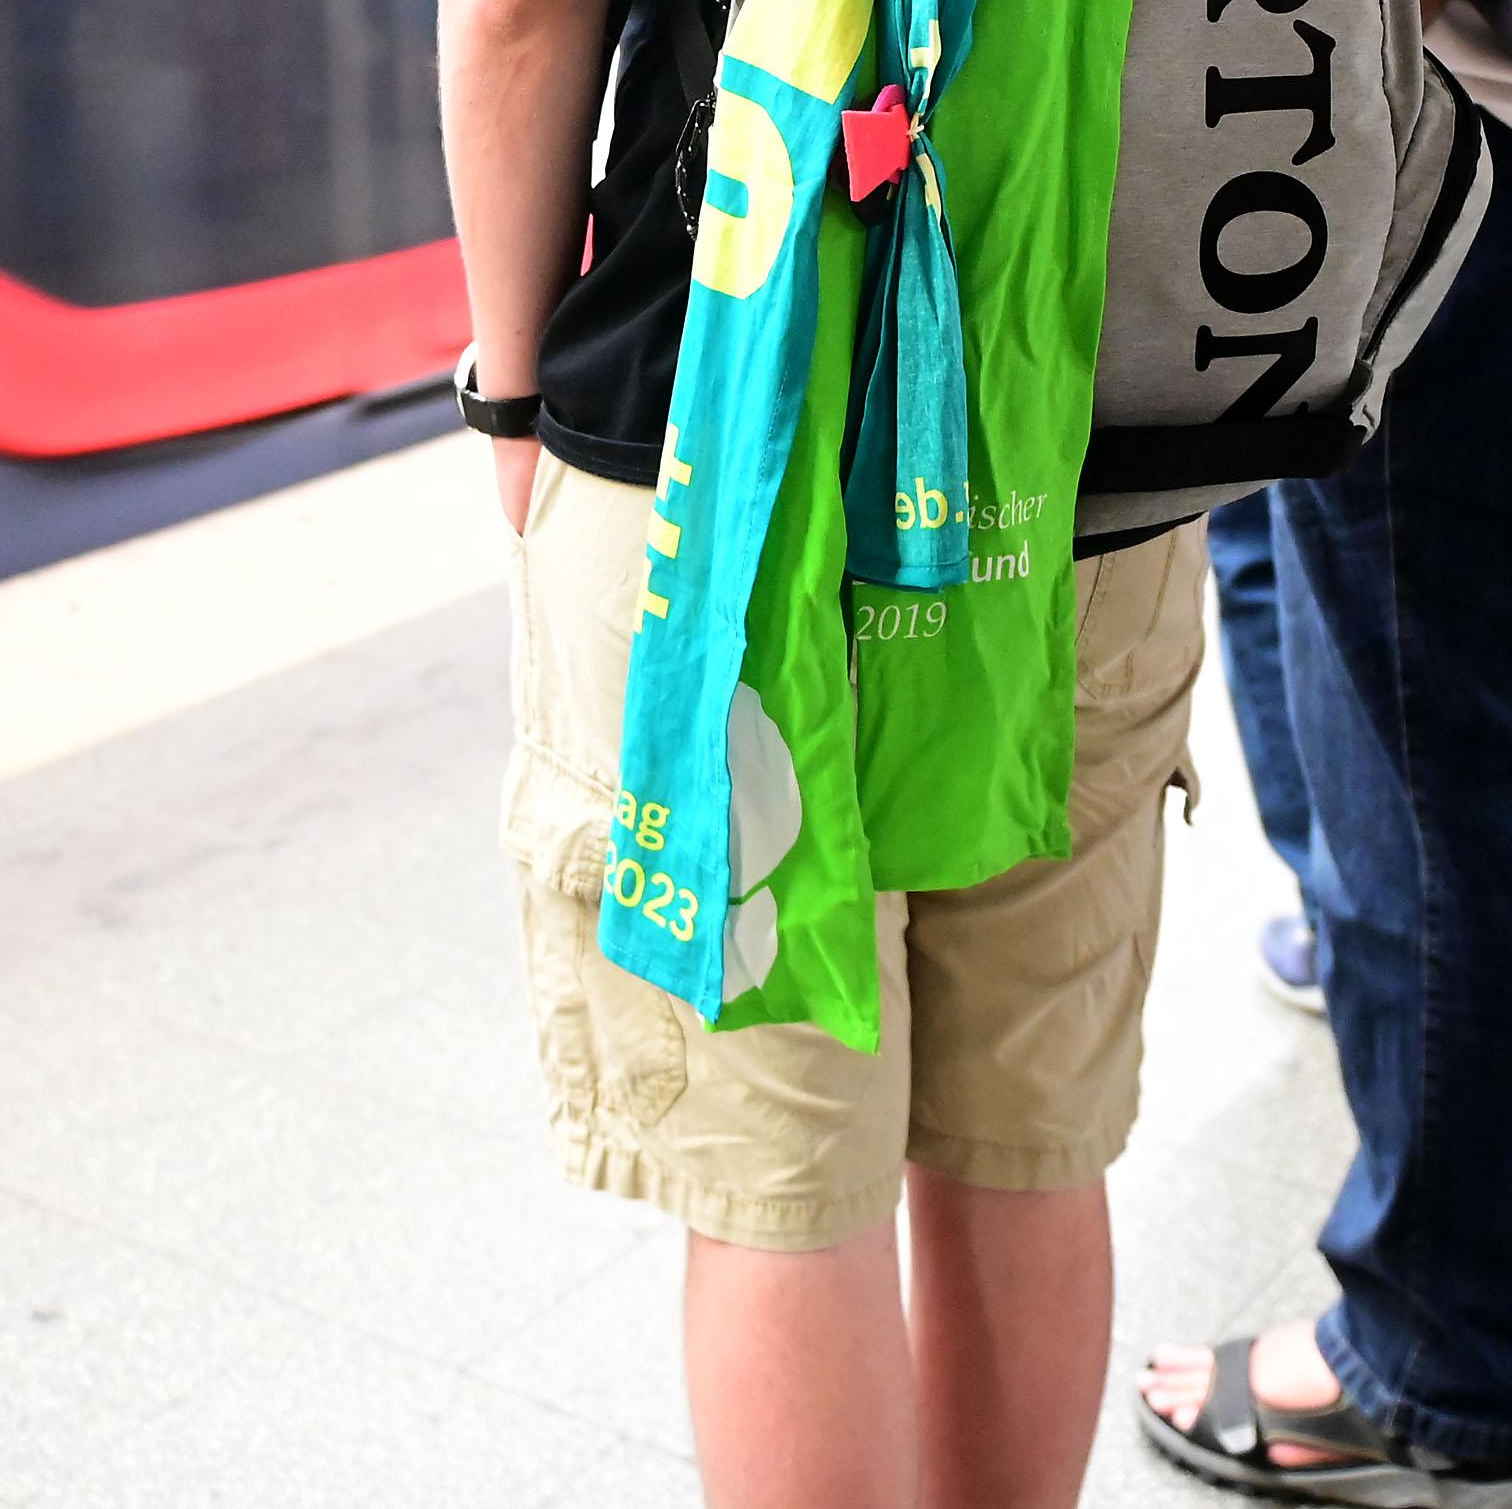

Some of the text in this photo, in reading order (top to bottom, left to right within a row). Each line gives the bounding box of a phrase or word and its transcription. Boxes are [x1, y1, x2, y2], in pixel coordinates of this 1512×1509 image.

[969, 540, 1030, 583] und
[855, 601, 948, 641] 2019
[603, 839, 700, 942] 2023
